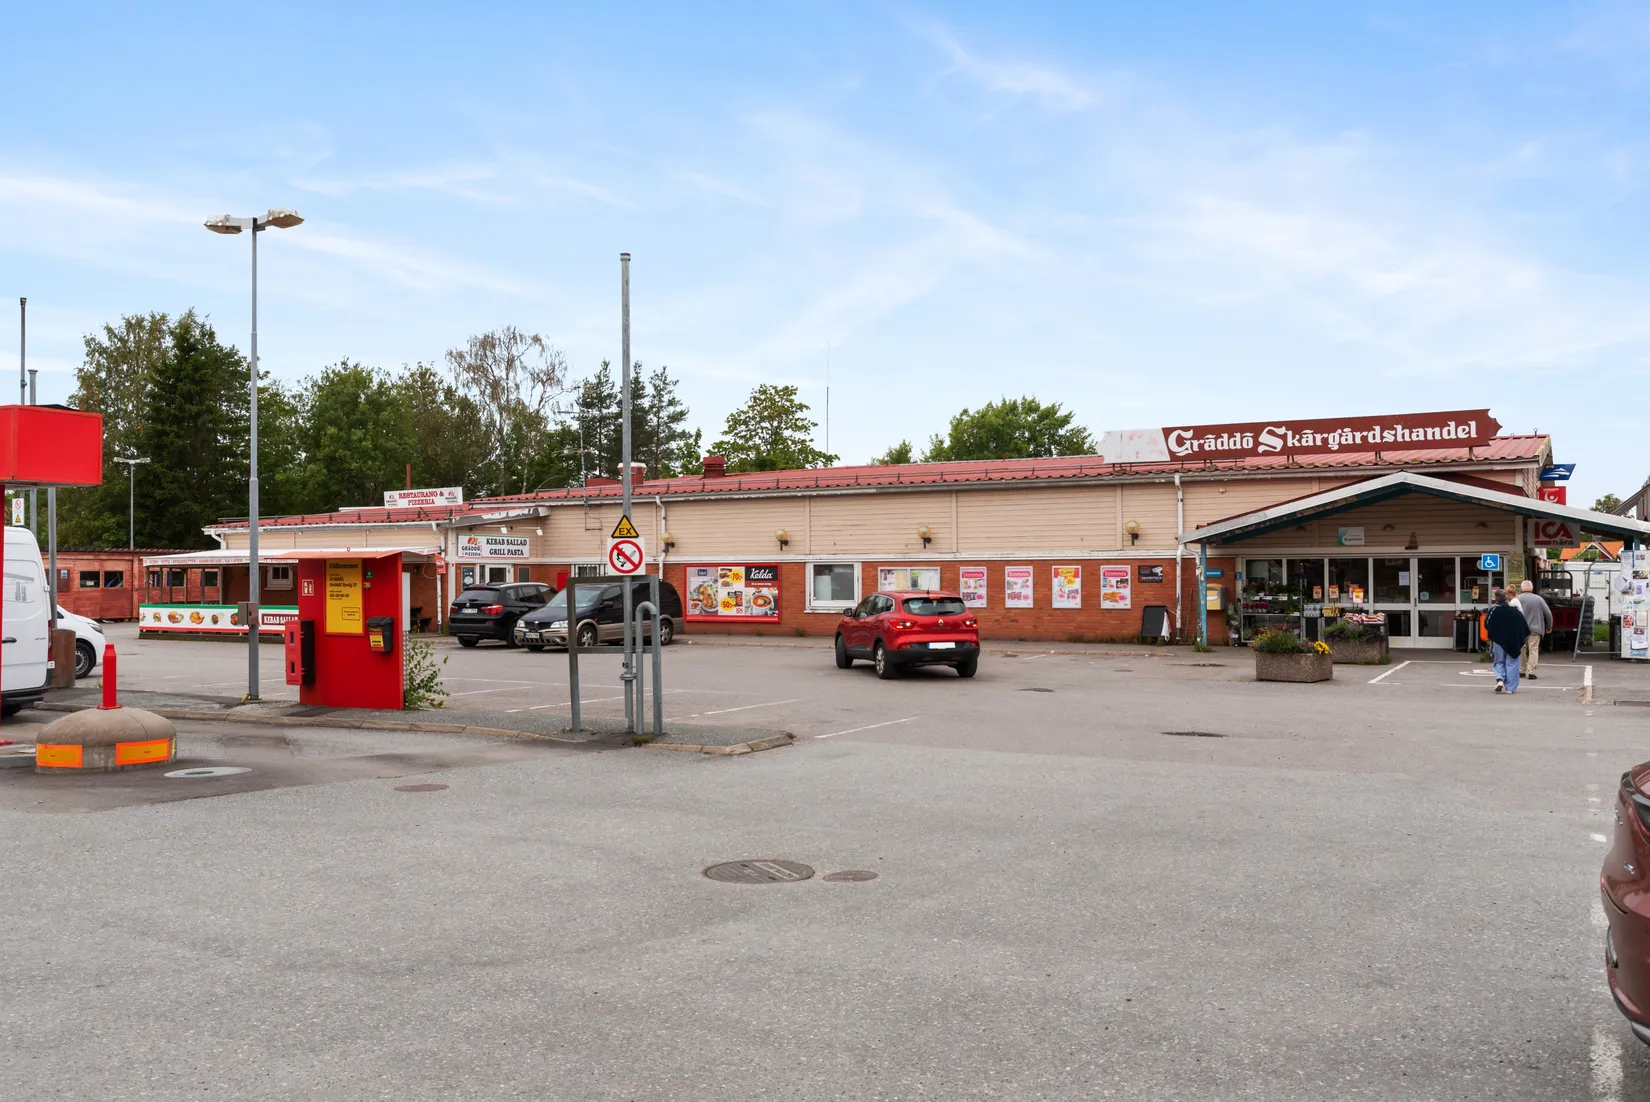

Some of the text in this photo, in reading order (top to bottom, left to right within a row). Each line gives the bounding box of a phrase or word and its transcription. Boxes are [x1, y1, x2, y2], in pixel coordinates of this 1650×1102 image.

[1257, 420, 1478, 454] Skärgårdshandel
[407, 498, 436, 506] PIZZERIA
[618, 527, 633, 536] EX
[1534, 521, 1574, 539] ICA
[486, 538, 527, 547] KEBAB SALLAD
[489, 548, 524, 556] GRILL PASTA
[750, 568, 773, 580] Kelda
